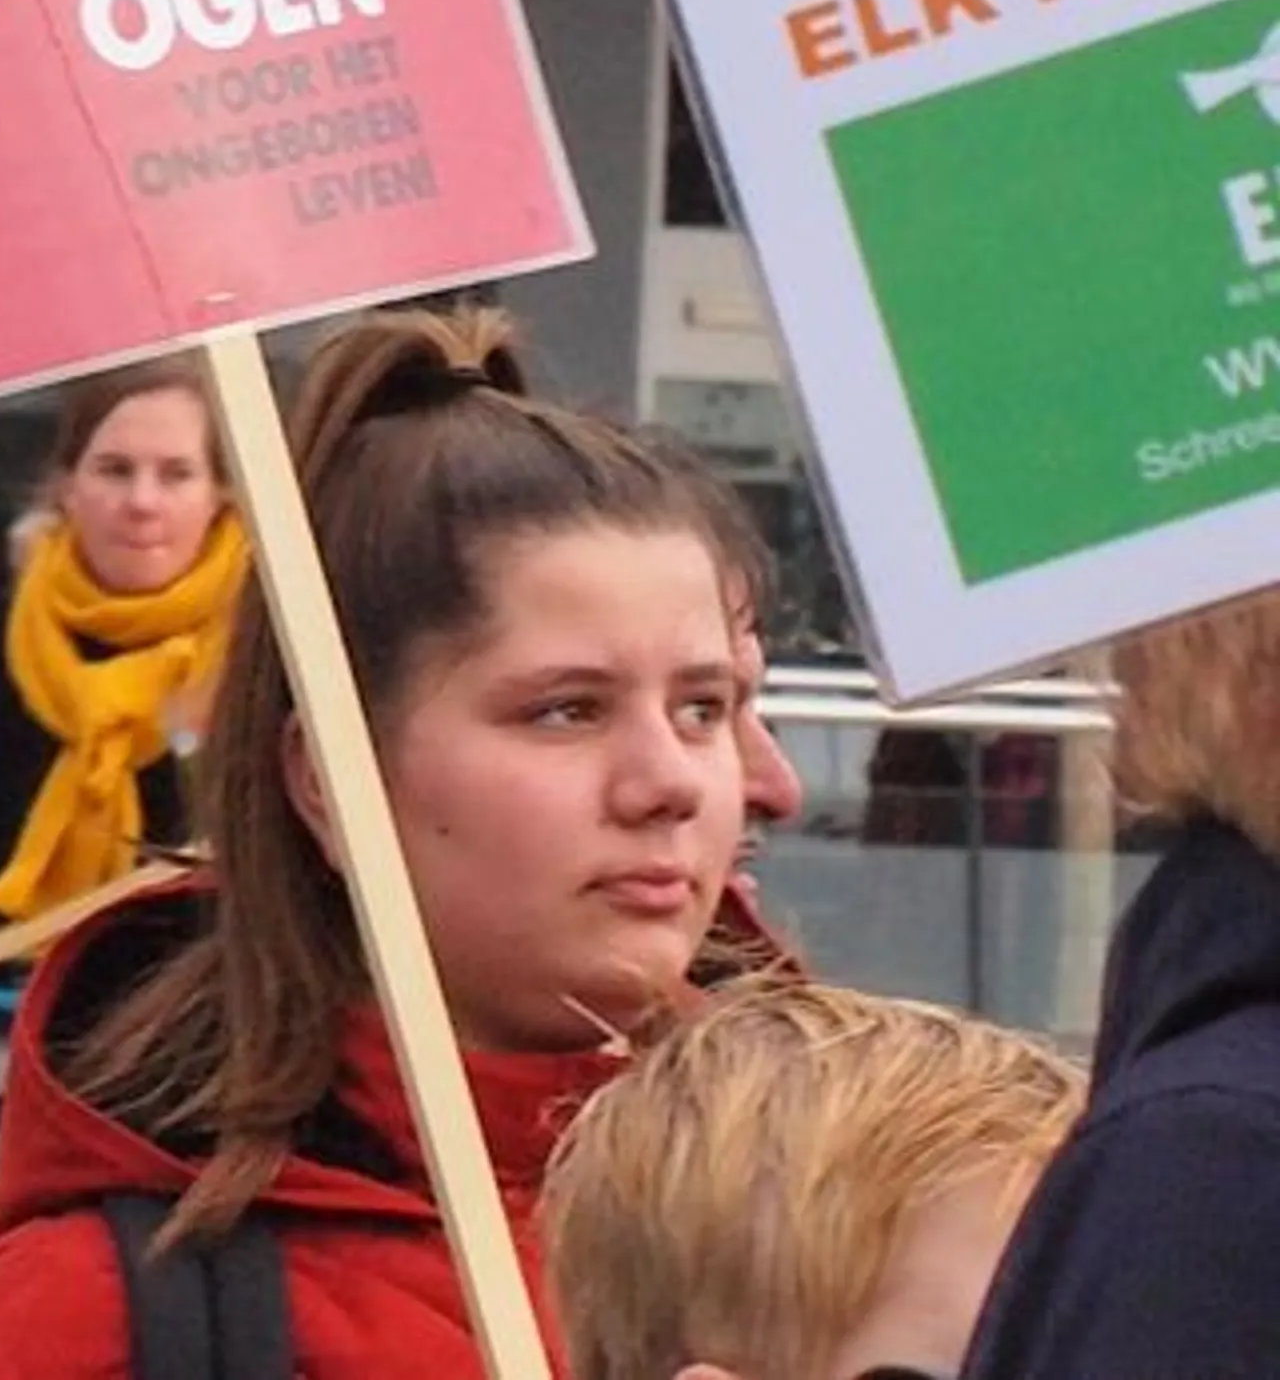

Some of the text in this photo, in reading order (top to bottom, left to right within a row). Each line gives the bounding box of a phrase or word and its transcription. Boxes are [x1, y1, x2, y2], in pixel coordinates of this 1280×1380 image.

[172, 34, 399, 118] VOOR HET
[130, 92, 420, 198] ONGEBOREN
